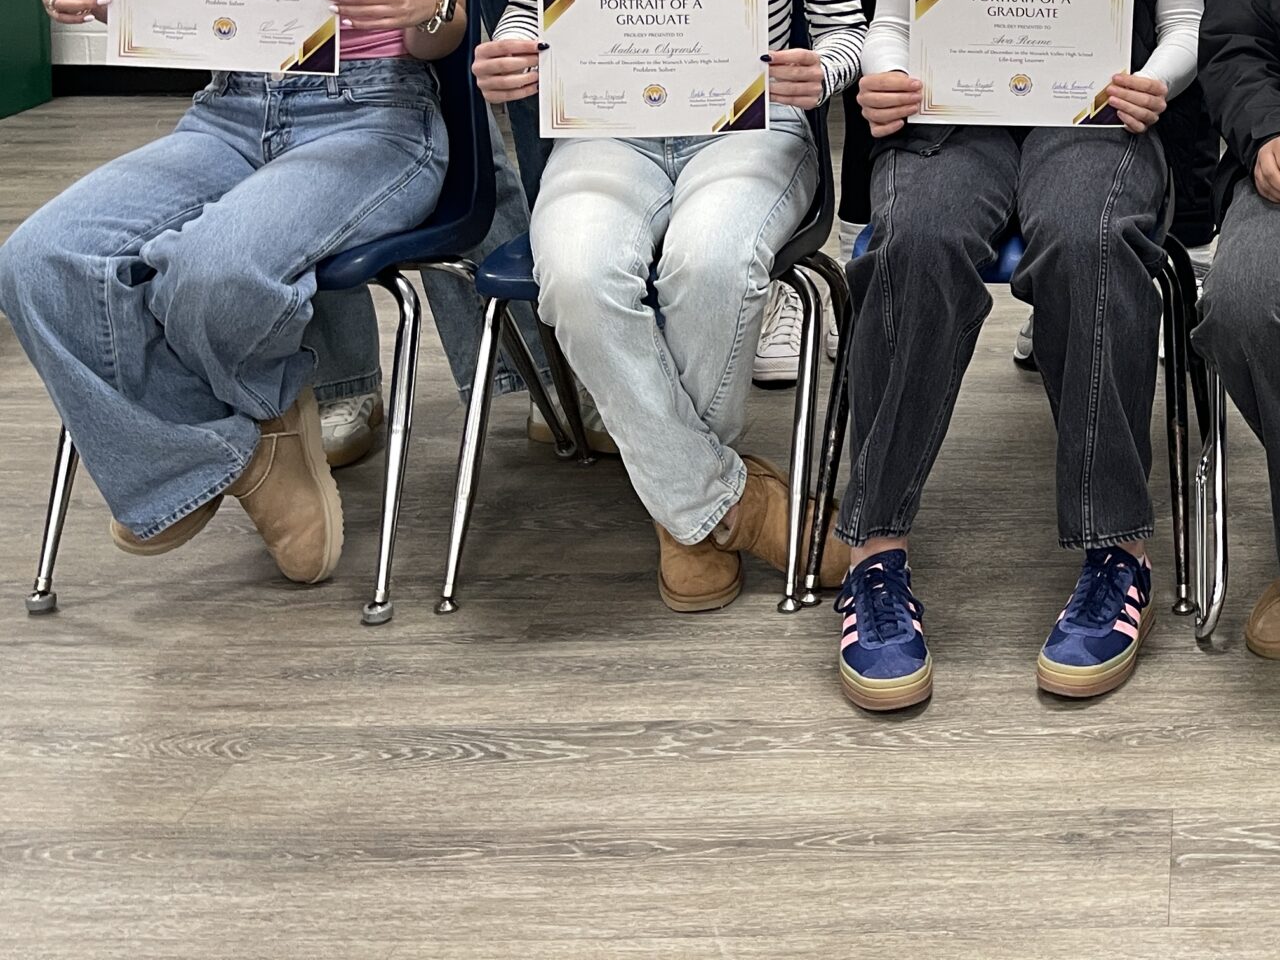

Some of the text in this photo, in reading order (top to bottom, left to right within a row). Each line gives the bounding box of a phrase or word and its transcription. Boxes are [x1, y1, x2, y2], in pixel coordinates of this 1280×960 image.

[987, 6, 1059, 18] GRADUATE
[616, 14, 691, 25] GRADUATE
[606, 41, 703, 59] Madison Olszewski
